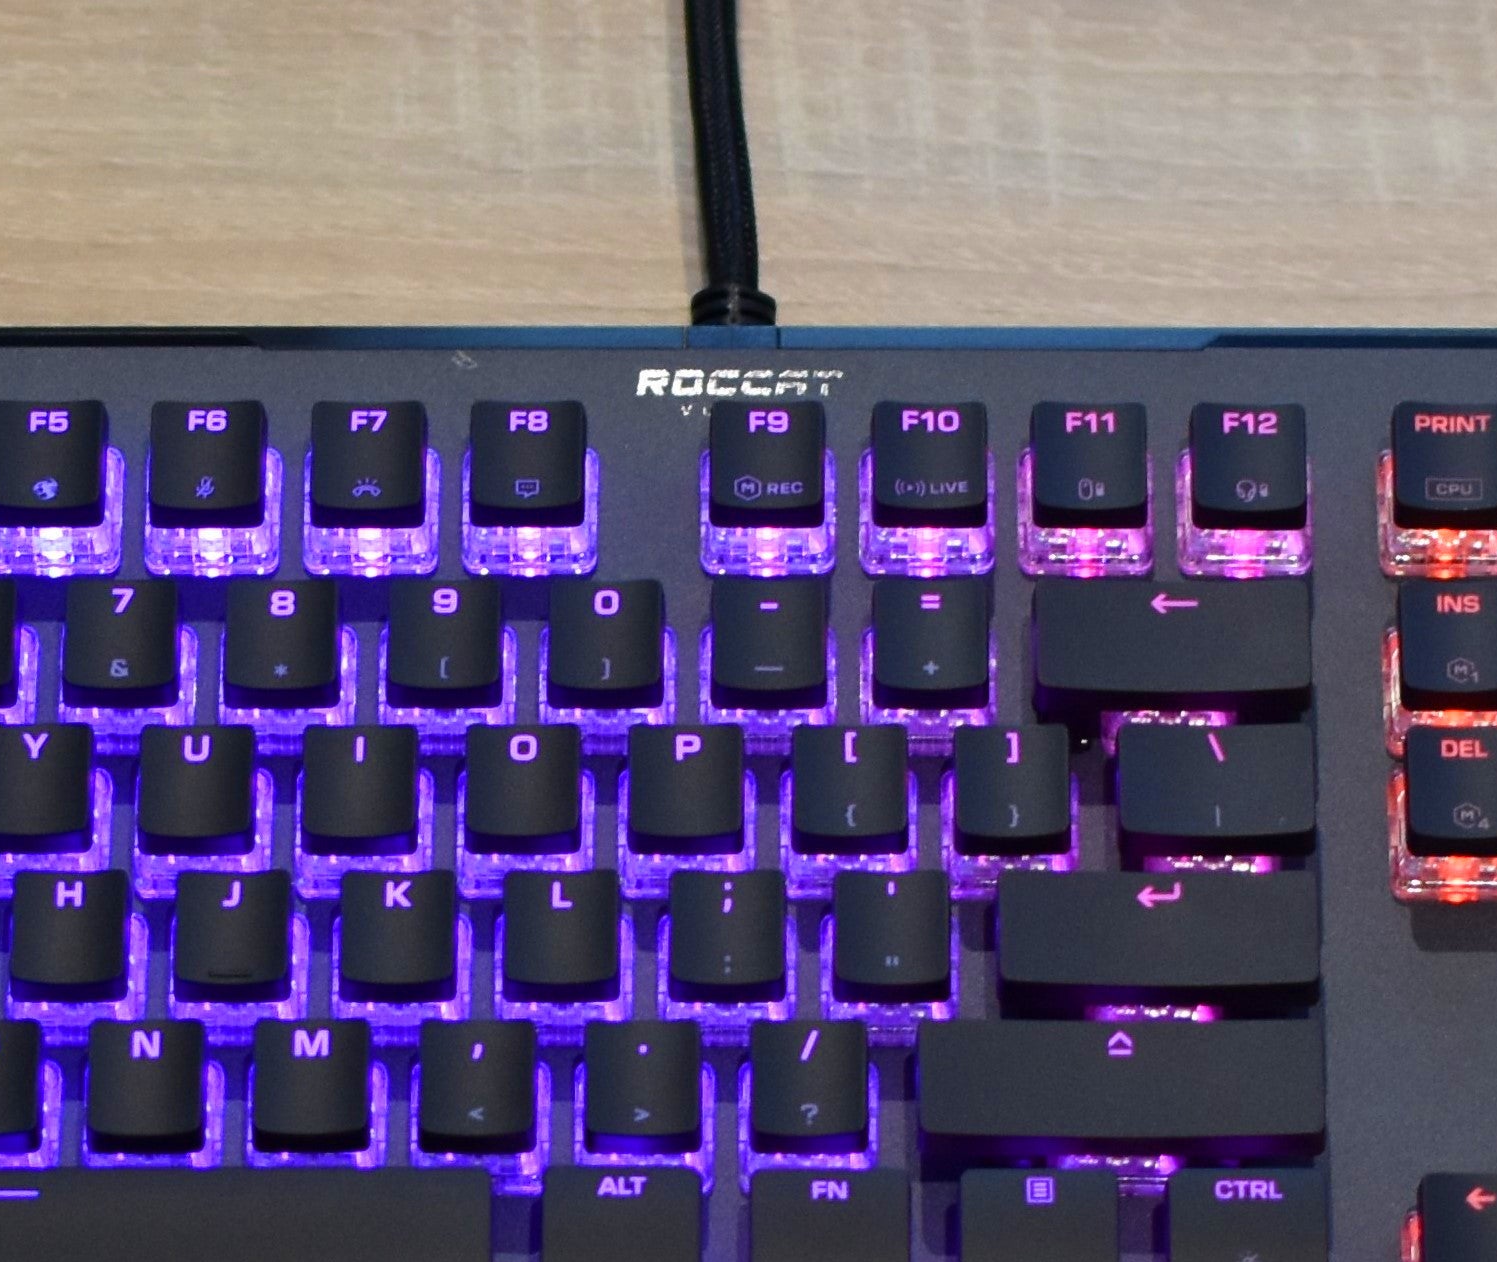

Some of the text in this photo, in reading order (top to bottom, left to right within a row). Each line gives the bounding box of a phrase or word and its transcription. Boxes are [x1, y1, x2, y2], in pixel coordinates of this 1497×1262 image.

[636, 369, 844, 396] ROCCAT
[29, 410, 69, 433] F5
[187, 409, 227, 432] F6
[350, 410, 388, 432] F7
[509, 410, 548, 432] F8
[748, 410, 789, 434] F9
[902, 409, 960, 433] F10
[1065, 411, 1115, 434] F11
[1222, 412, 1278, 435] F12
[1414, 414, 1491, 434] PRINT
[766, 481, 803, 495] REC
[929, 480, 968, 495] LIVE
[1435, 482, 1474, 497] CPU
[111, 587, 134, 614] 7
[270, 590, 295, 616] 8
[432, 588, 458, 614] 9
[594, 589, 620, 616] 0
[1436, 594, 1481, 614] INS
[22, 732, 49, 759] Y
[183, 734, 210, 762] U
[355, 735, 365, 763] I
[509, 734, 538, 762] O
[675, 734, 702, 761] P
[1440, 739, 1489, 759] DEL
[56, 880, 83, 908] H
[222, 880, 241, 908] J
[385, 880, 412, 908] K
[551, 881, 573, 909] L
[131, 1030, 161, 1059] N
[293, 1029, 330, 1058] M
[597, 1175, 647, 1196] ALT
[811, 1180, 849, 1200] FN
[1214, 1179, 1283, 1200] CTRL
